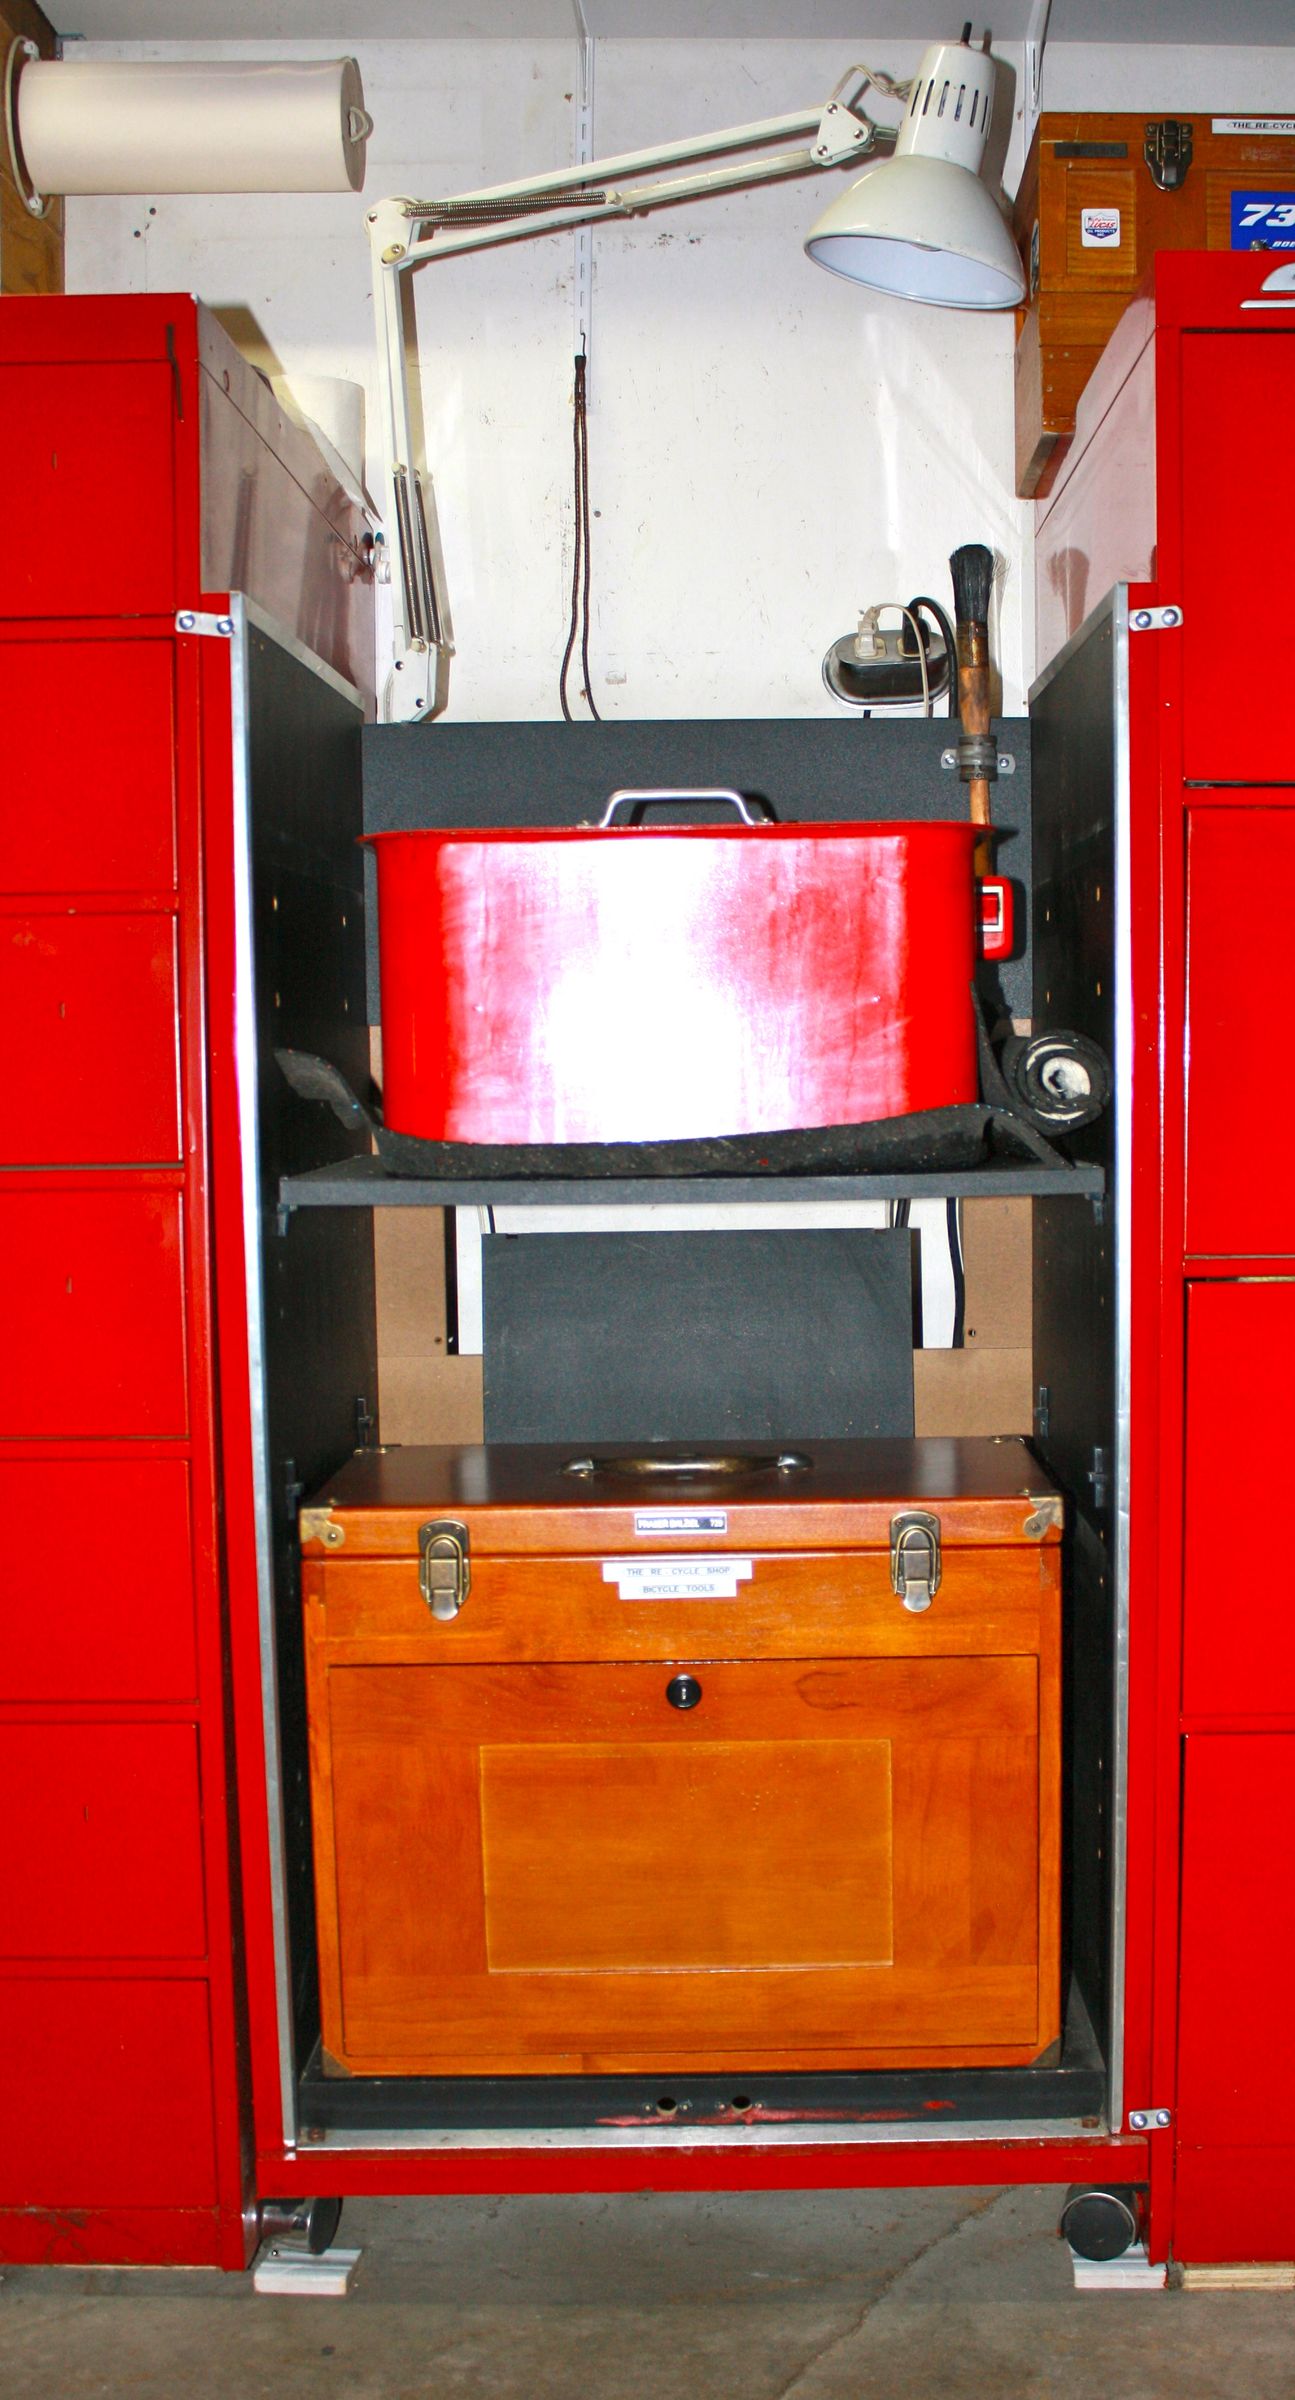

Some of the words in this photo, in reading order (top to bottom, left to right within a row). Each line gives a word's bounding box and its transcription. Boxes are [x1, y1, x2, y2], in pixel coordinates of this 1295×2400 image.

[1232, 121, 1251, 129] THE
[1089, 221, 1116, 229] LUCAS
[626, 1568, 643, 1576] THE
[650, 1568, 662, 1576] RE
[671, 1567, 700, 1576] CYCLE
[706, 1567, 731, 1575] SHOP
[643, 1585, 679, 1593] BICYCLE
[686, 1584, 715, 1592] TOOLS
